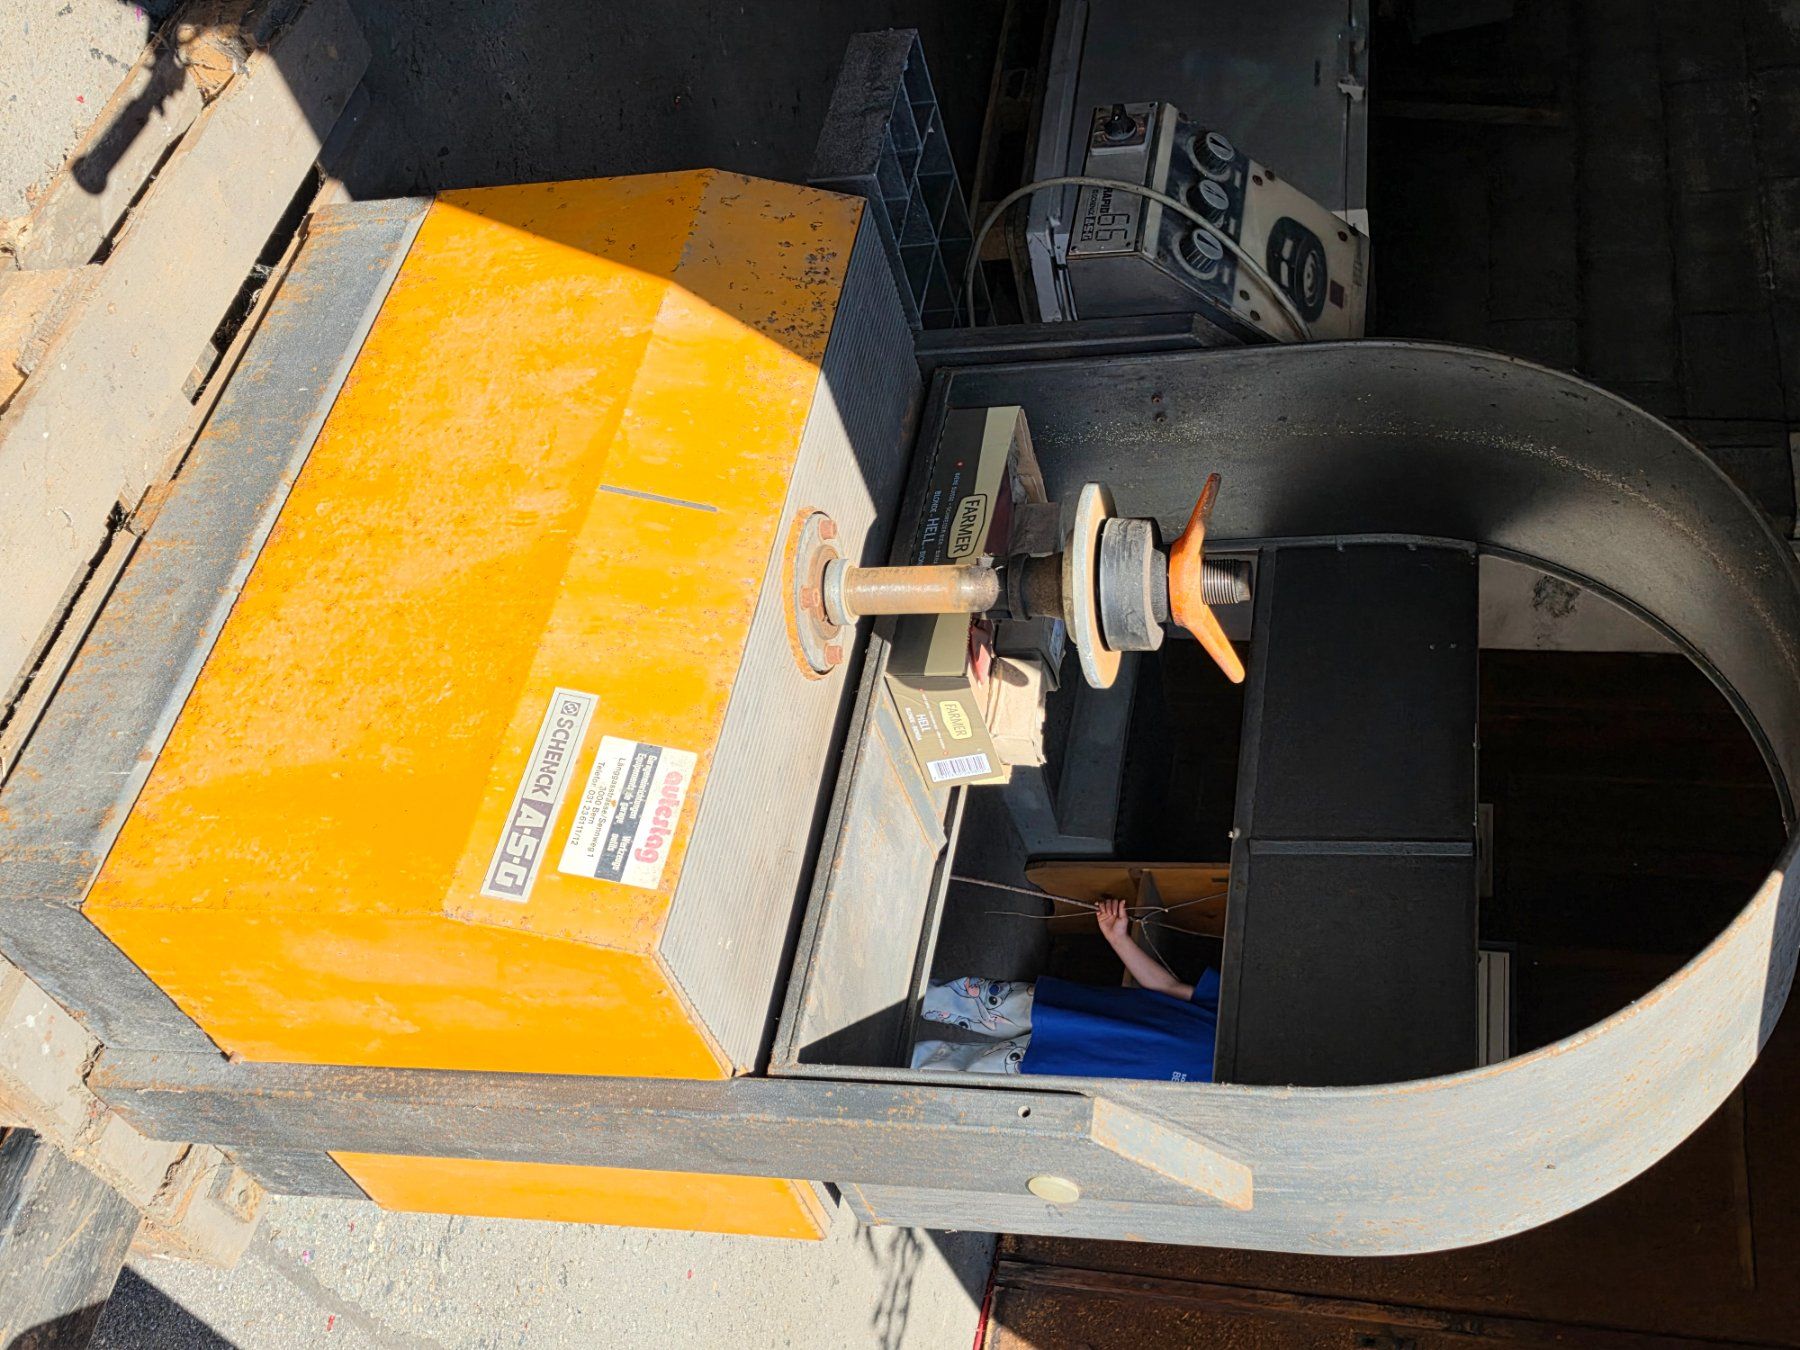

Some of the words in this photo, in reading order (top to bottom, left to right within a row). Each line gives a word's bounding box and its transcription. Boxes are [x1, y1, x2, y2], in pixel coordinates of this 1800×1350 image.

[1095, 213, 1131, 242] 66
[929, 490, 942, 513] BLONDE
[921, 517, 940, 546] HELL
[953, 499, 981, 554] FARMER
[944, 703, 967, 737] FARMER
[531, 716, 574, 797] SCHENCK
[584, 789, 596, 804] 031
[594, 786, 606, 806] 3000
[588, 807, 600, 825] Bern
[607, 833, 621, 852] outils
[611, 835, 632, 871] Werkzeuge
